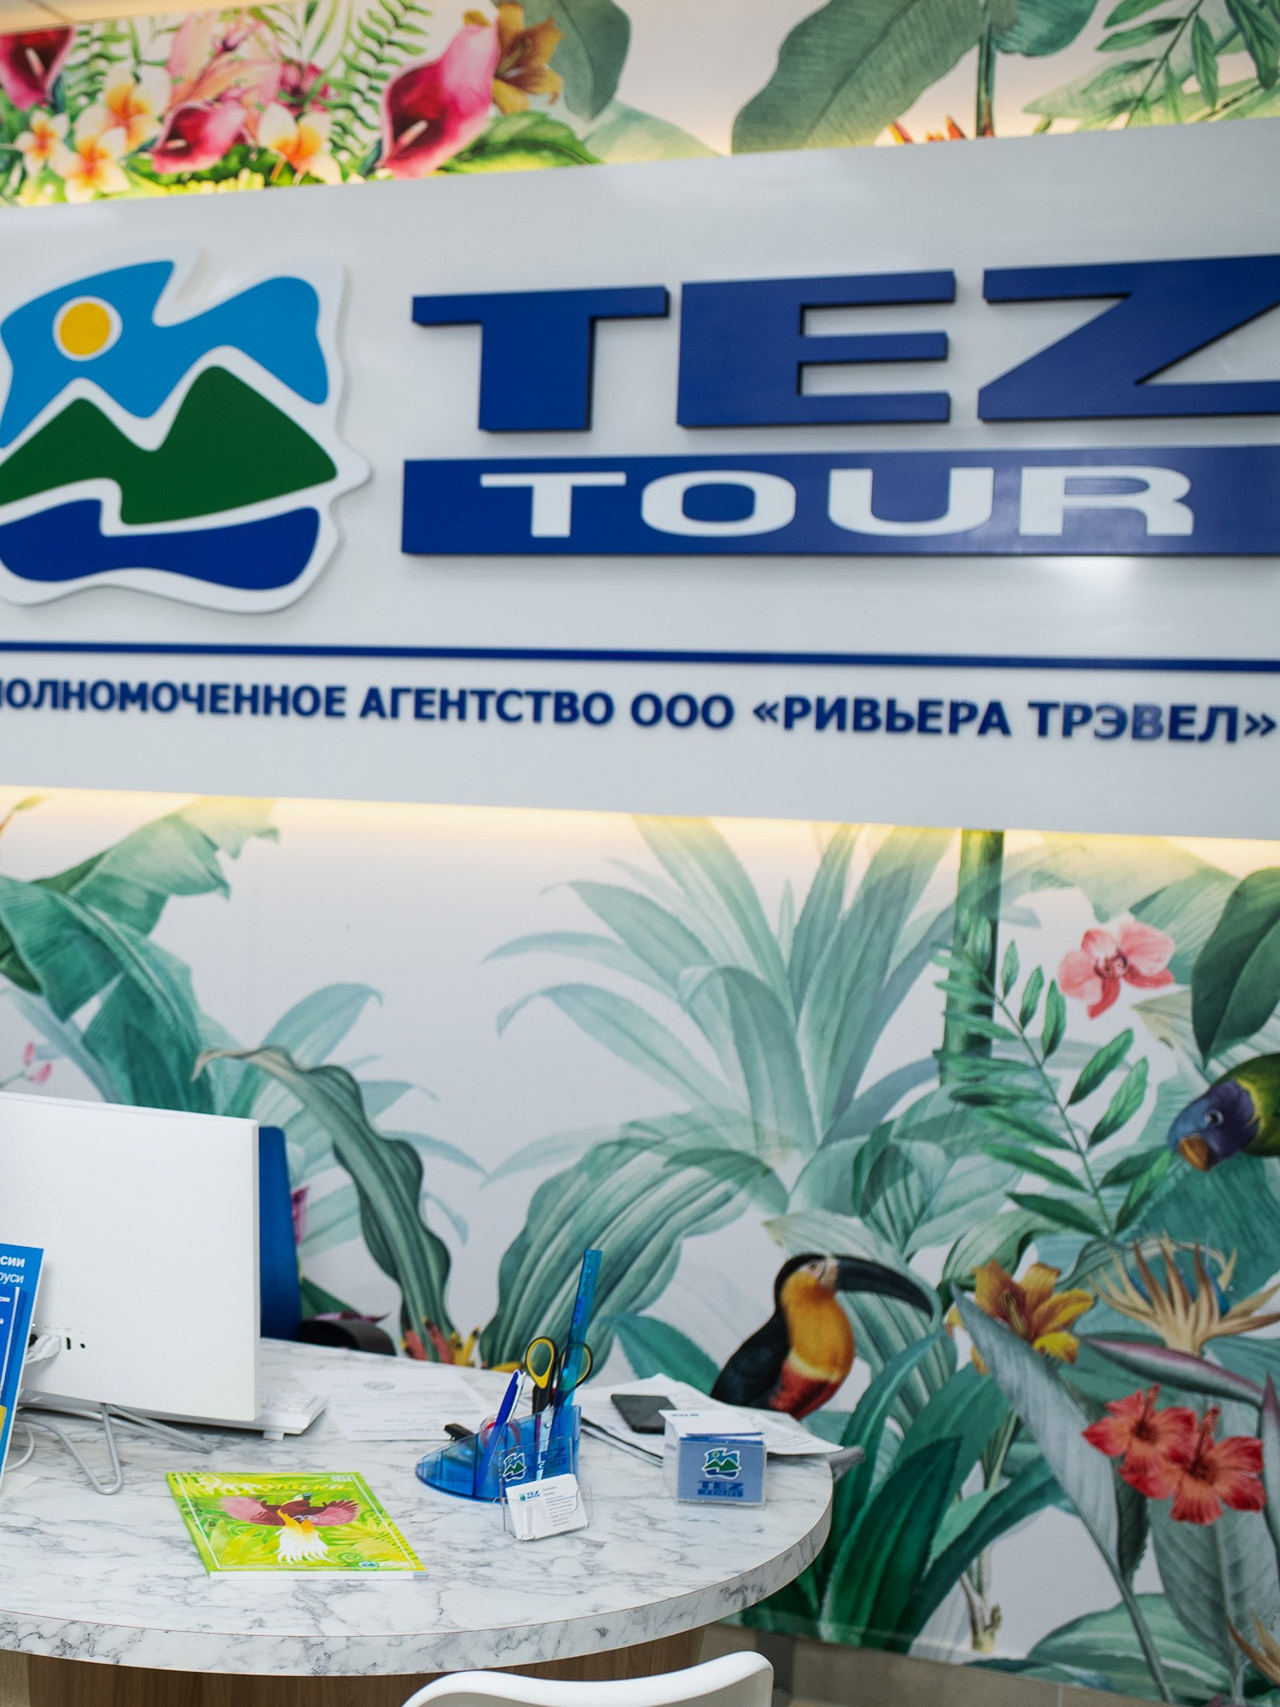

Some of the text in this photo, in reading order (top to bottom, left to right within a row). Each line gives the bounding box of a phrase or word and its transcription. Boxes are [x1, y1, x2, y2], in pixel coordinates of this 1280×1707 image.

[412, 255, 1280, 433] TEZ
[480, 465, 1195, 539] TOUR
[359, 686, 615, 727] АГЕНТСТВО
[630, 692, 736, 730] ООО
[752, 695, 1012, 737] «РИВЬЕРА
[1028, 701, 1278, 744] ТРЭВЕЛ»
[698, 1480, 744, 1491] TEZ
